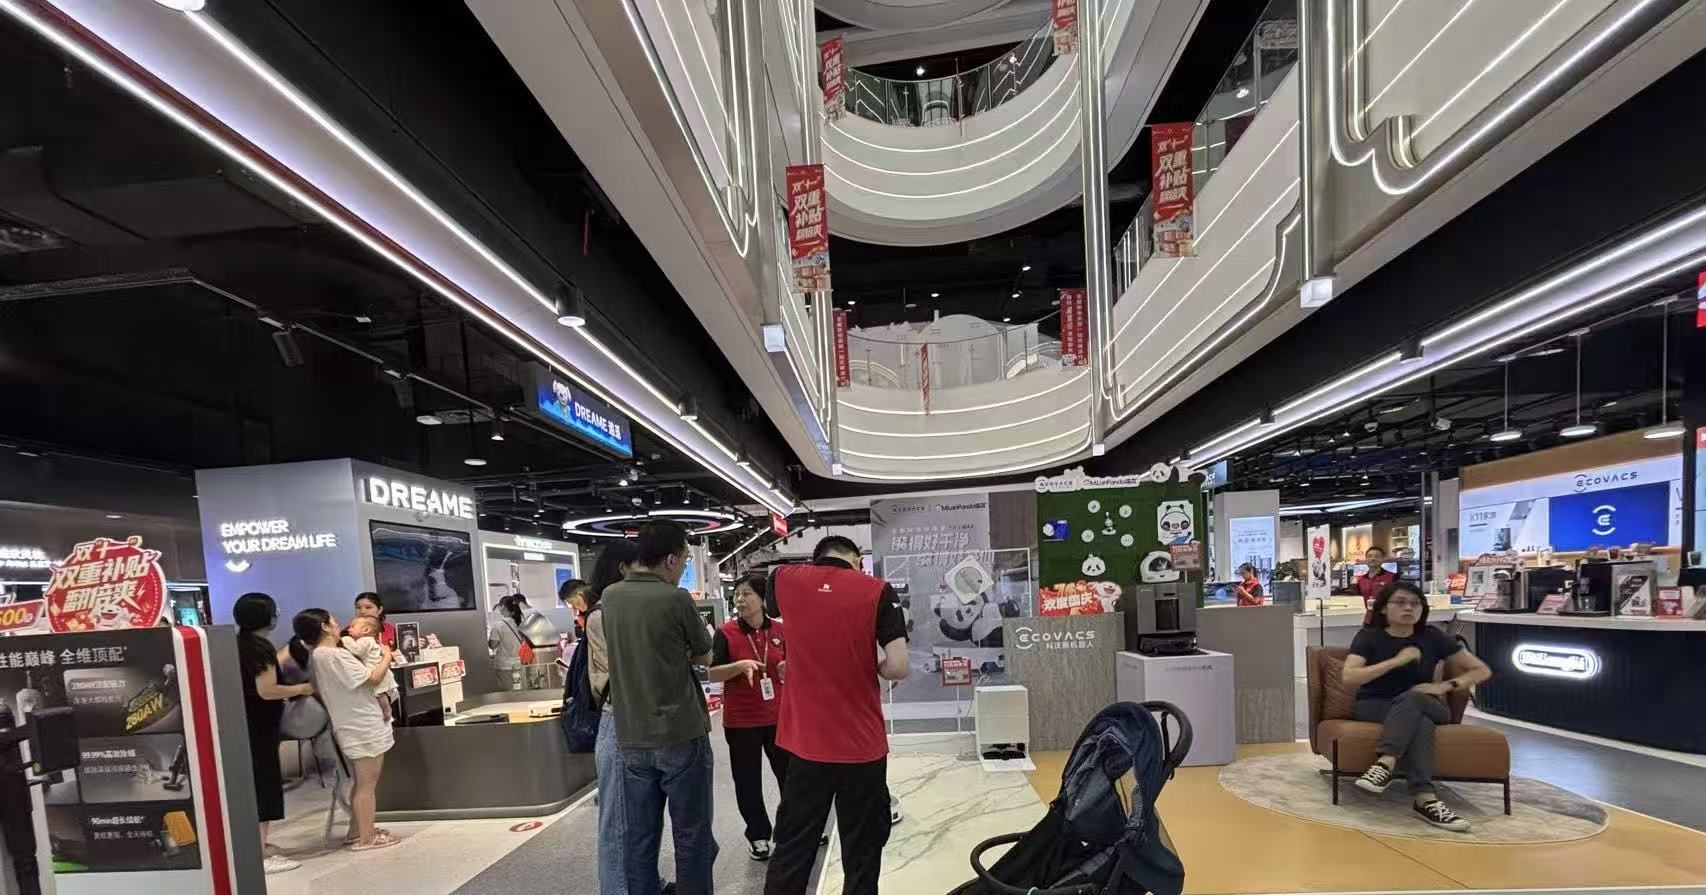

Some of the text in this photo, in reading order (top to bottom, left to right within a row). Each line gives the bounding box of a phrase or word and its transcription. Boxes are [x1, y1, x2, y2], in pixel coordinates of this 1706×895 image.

[791, 189, 821, 216] 双重
[796, 204, 824, 228] 补贴
[575, 401, 608, 433] DREAME
[1575, 472, 1639, 490] ECOVACS
[369, 477, 474, 519] DREAME
[221, 519, 289, 537] EMPOWER
[223, 533, 337, 553] YOUR DREAM LIFE
[46, 555, 151, 595] 双重补贴
[63, 580, 142, 613] 翻倍爽
[1017, 629, 1095, 647] ECOVACS
[1046, 640, 1094, 650] 科沃斯机器人
[126, 693, 164, 730] 280AW
